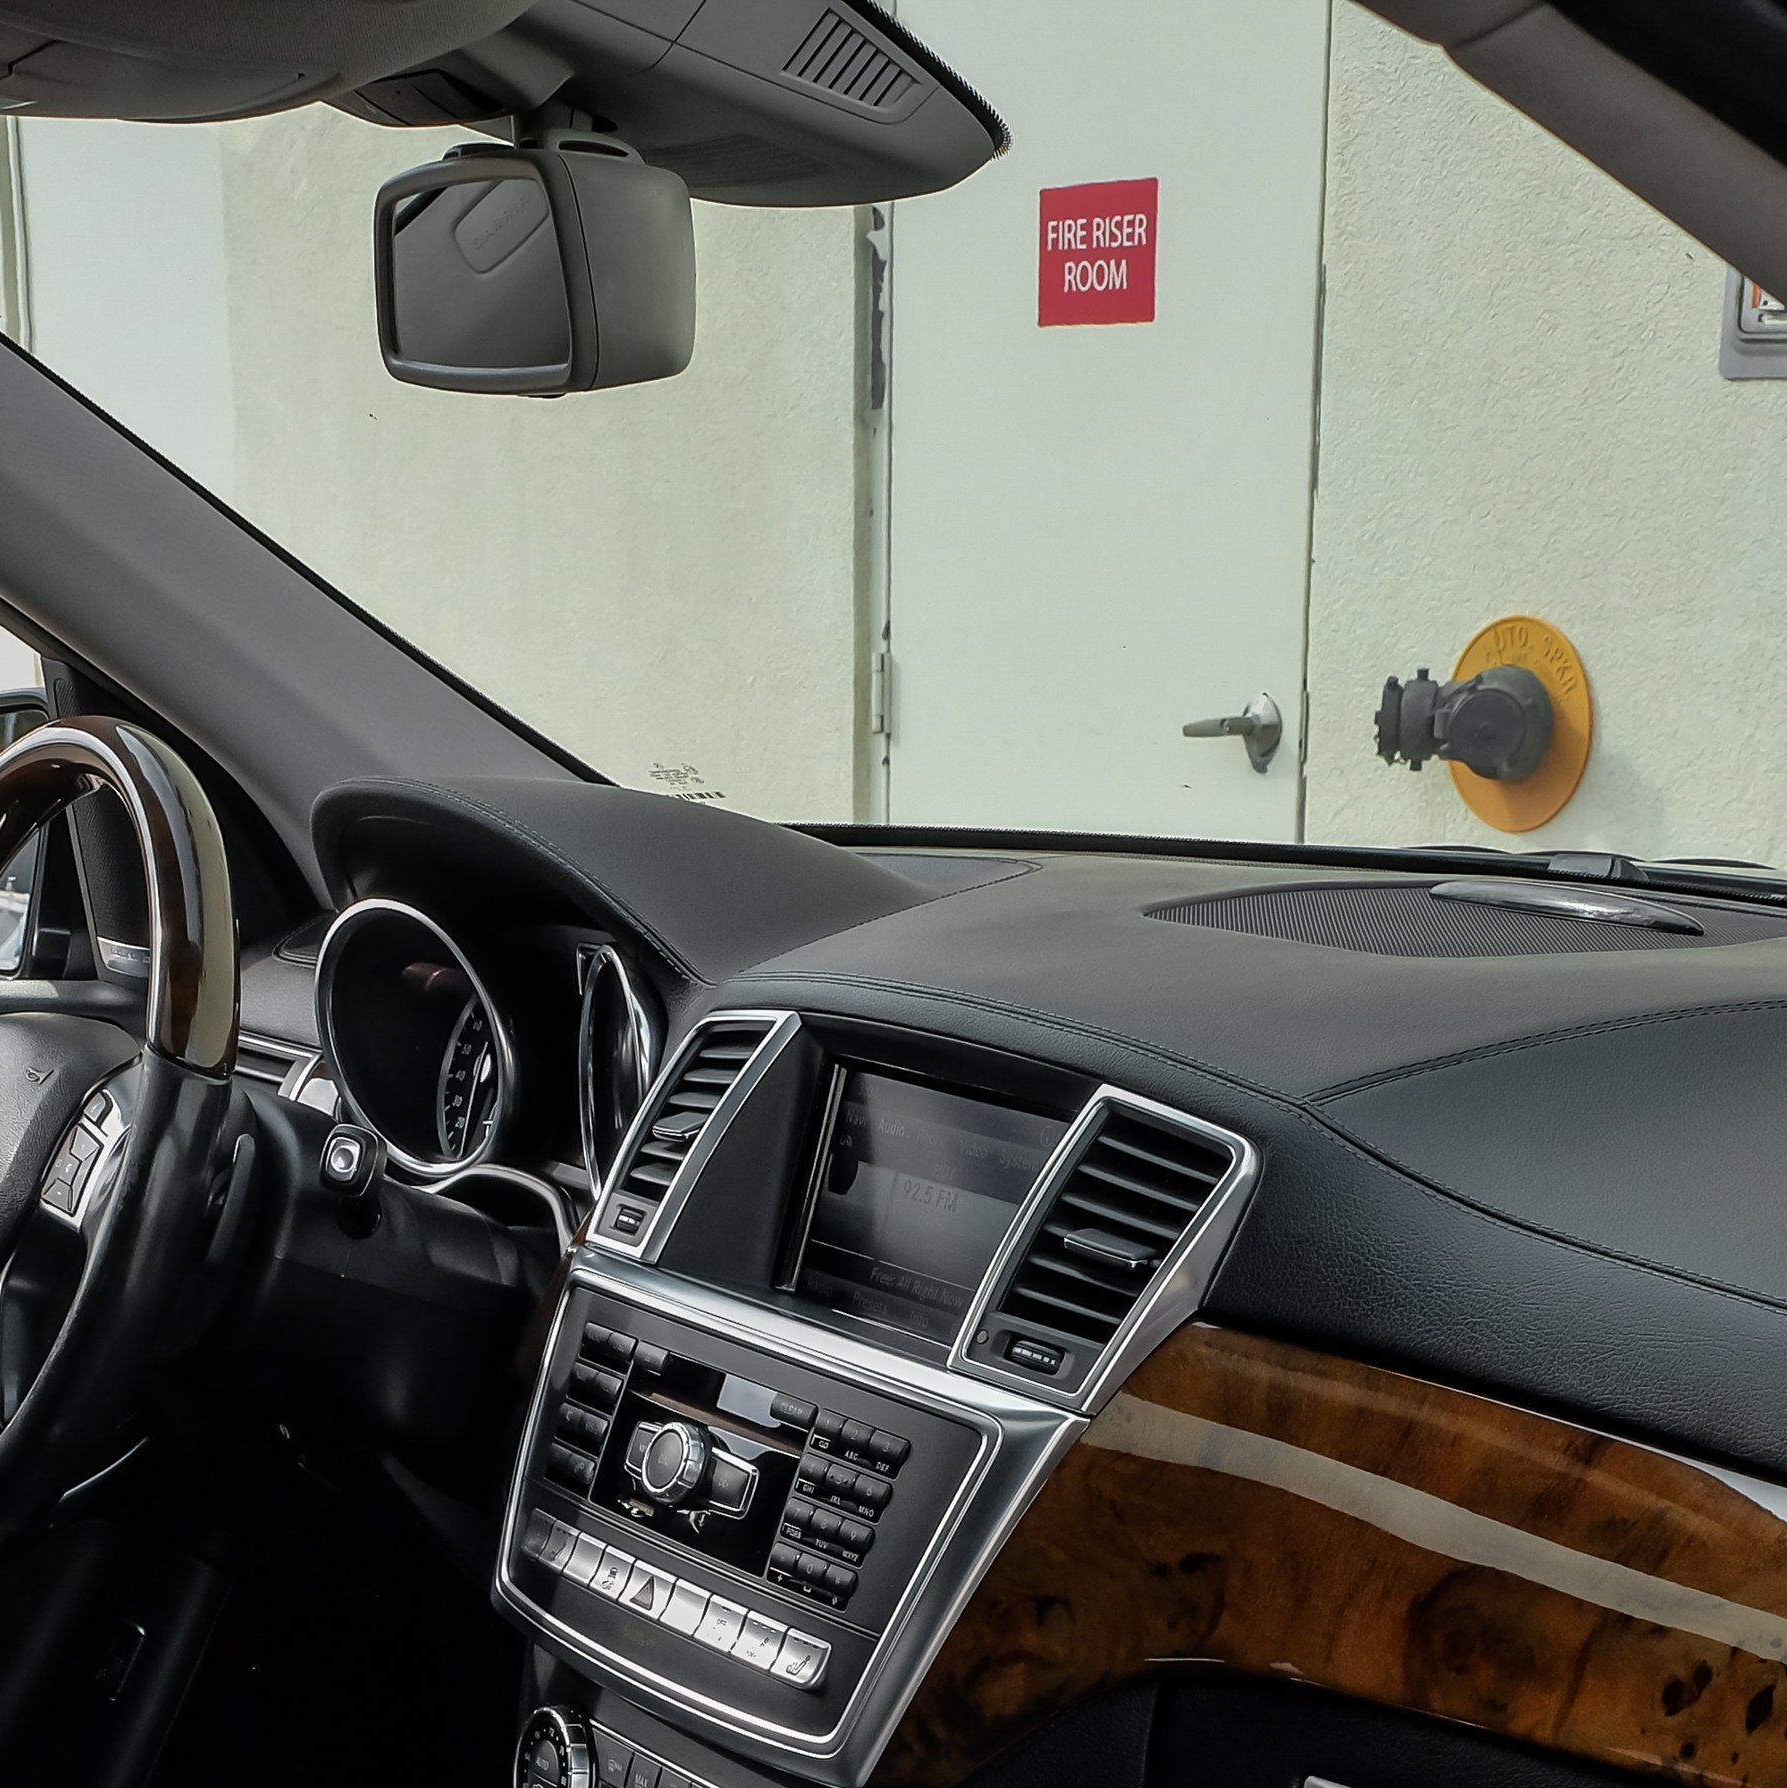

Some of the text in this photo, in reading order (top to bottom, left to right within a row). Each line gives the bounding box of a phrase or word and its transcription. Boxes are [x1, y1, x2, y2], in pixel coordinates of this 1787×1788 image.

[1047, 213, 1147, 251] FIRE RISER
[1064, 259, 1128, 293] ROOM
[903, 1180, 959, 1212] 92.5 FM
[876, 1461, 891, 1472] DEF
[635, 1773, 647, 1788] MAX
